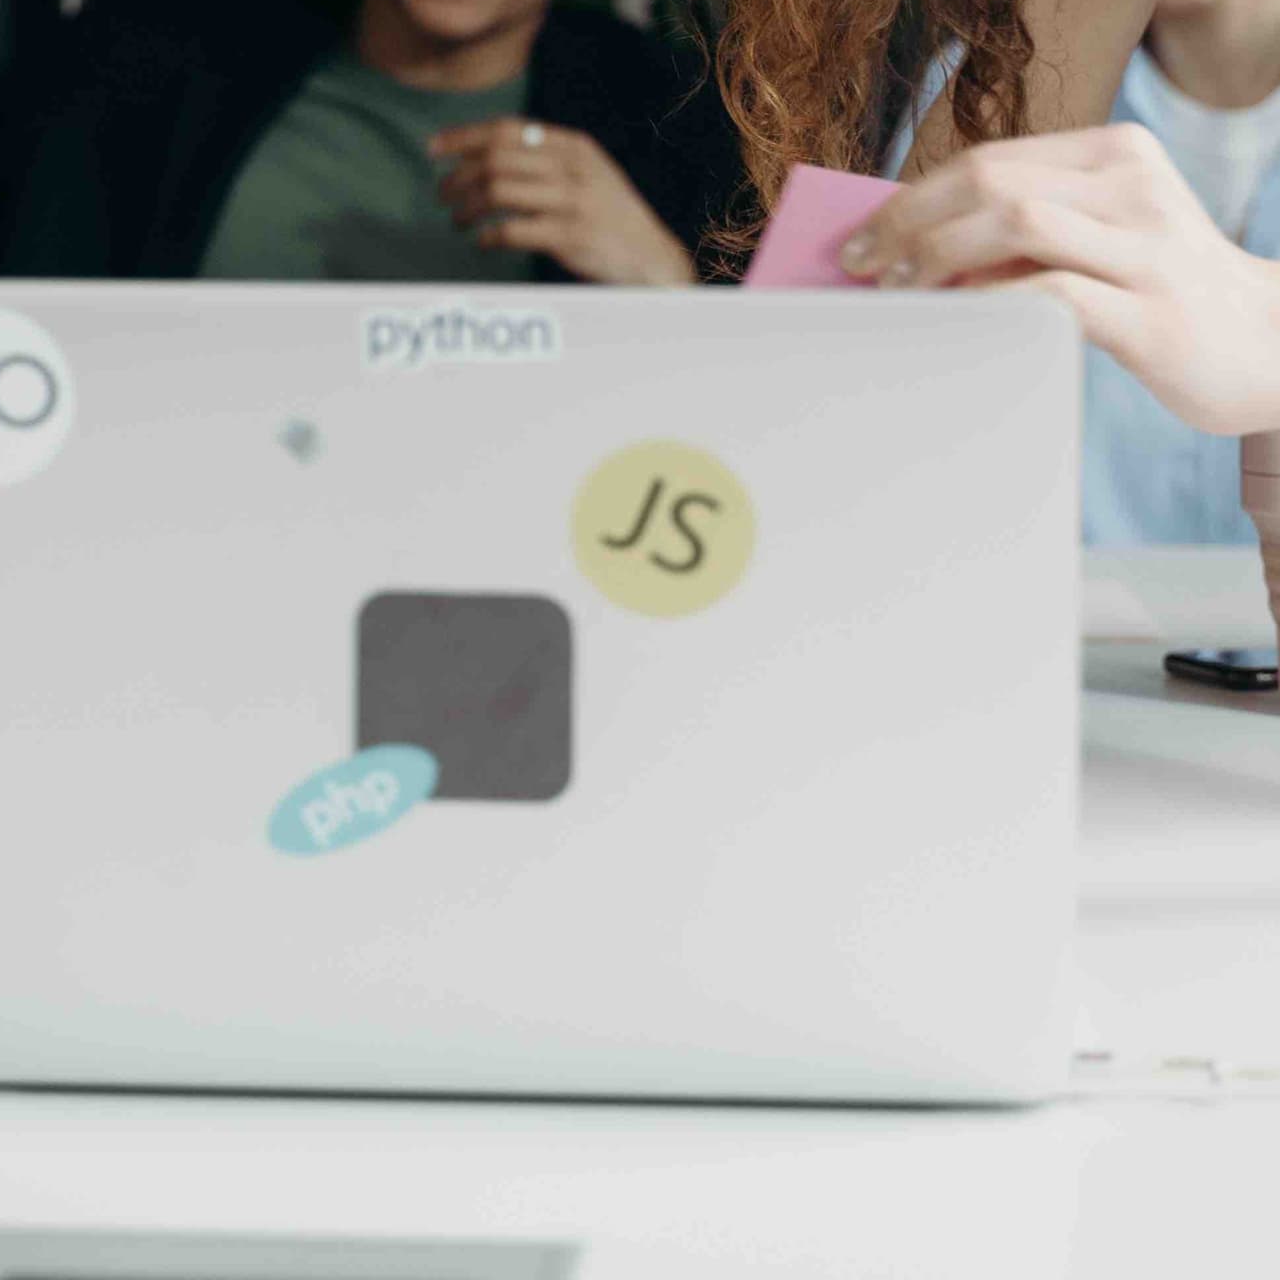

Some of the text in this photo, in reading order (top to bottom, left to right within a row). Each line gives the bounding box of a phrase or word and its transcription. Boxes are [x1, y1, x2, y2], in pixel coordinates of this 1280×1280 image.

[367, 310, 553, 363] python
[600, 478, 722, 576] JS
[301, 768, 400, 846] php
